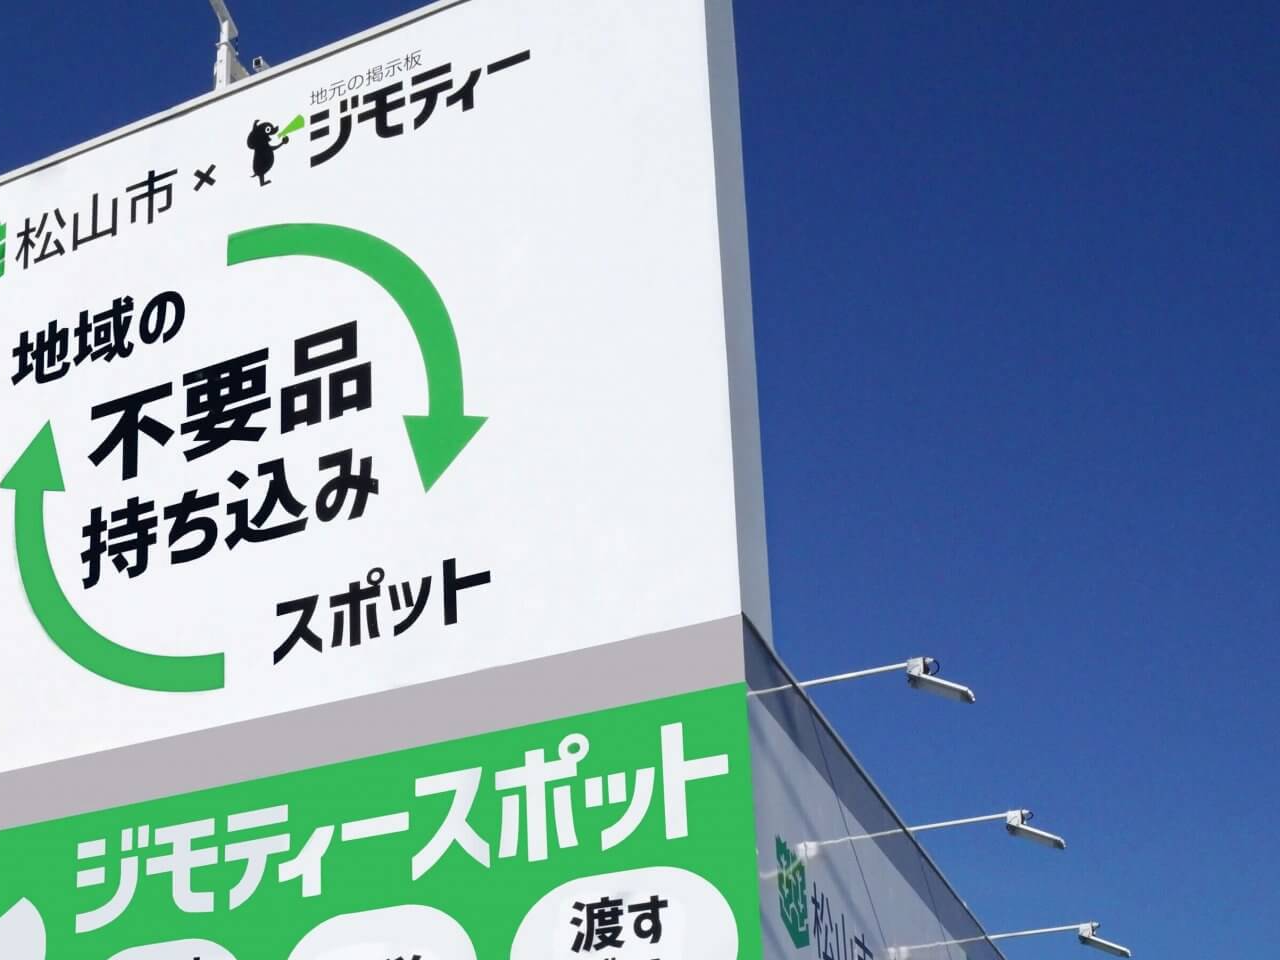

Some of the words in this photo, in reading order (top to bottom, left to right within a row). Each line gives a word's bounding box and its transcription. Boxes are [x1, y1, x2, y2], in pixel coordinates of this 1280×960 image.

[310, 50, 422, 106] 地元の掲示板
[15, 167, 178, 269] 松山市
[310, 49, 531, 168] ジモティー
[11, 291, 185, 386] 地域の
[87, 320, 372, 481] 不要品
[80, 448, 379, 590] 持ち込み
[273, 558, 491, 665] スポット
[75, 721, 729, 934] ジモティースポット
[569, 896, 669, 954] 渡す
